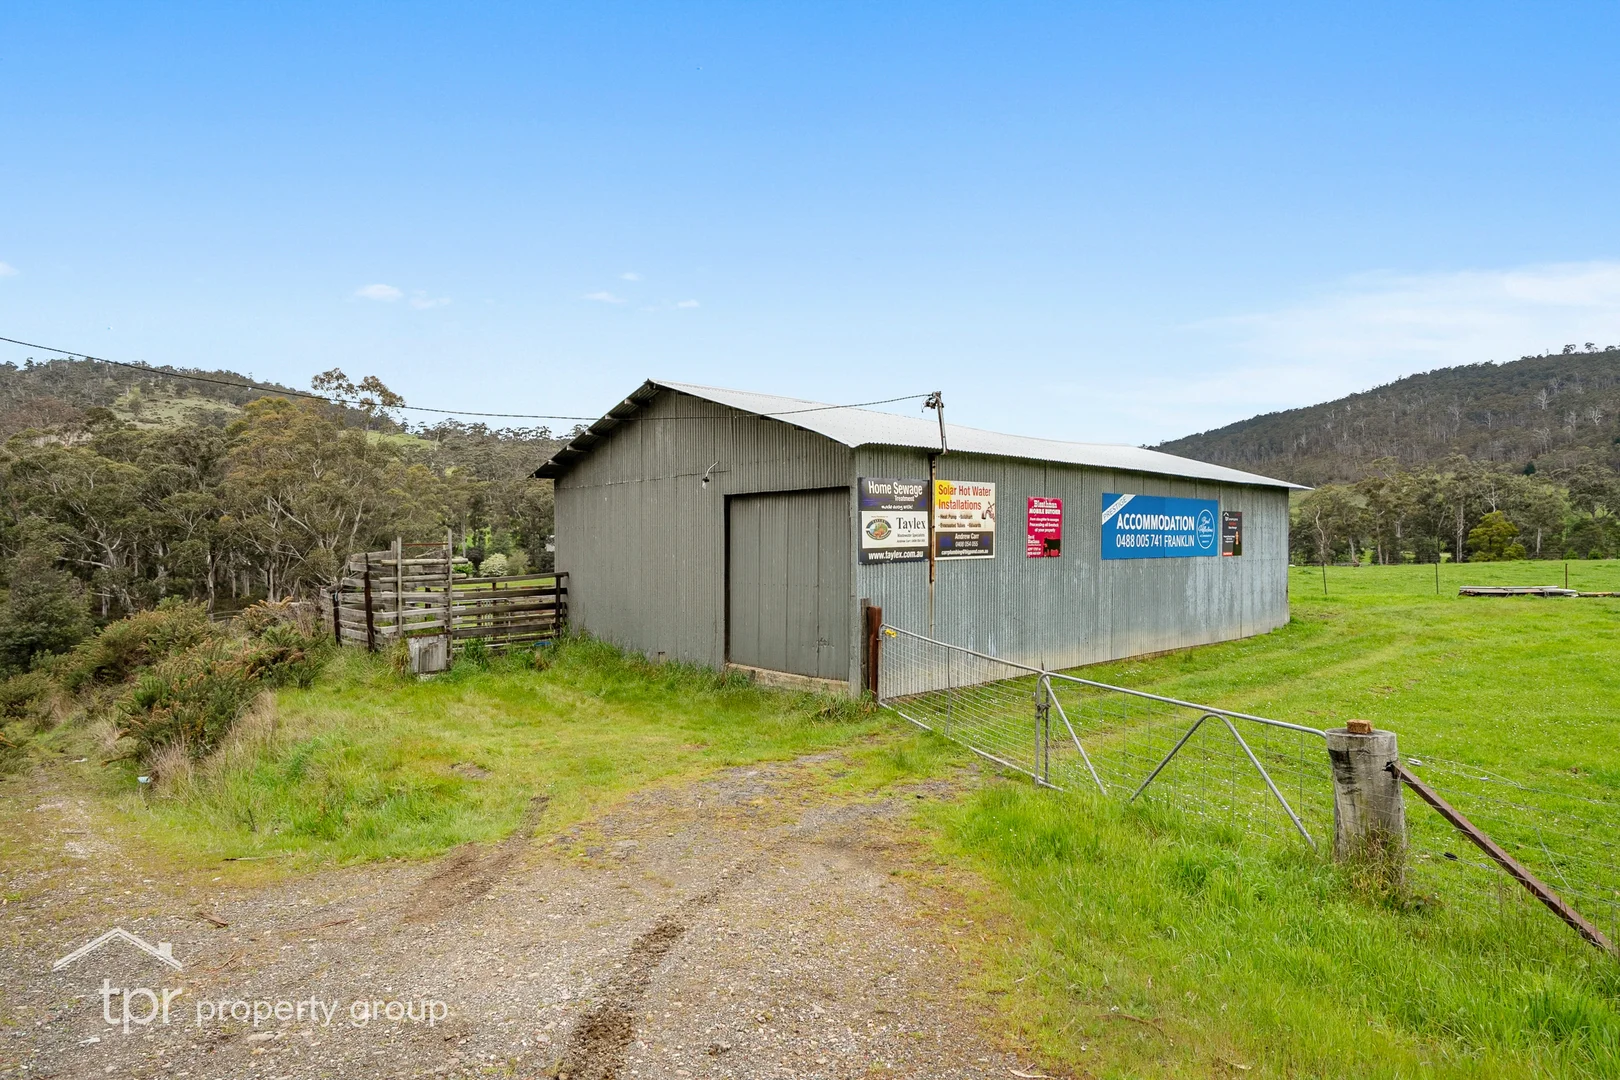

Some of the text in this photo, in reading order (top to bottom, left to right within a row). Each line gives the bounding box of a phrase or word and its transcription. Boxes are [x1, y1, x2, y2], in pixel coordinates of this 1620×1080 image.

[868, 480, 923, 498] Home Sewage
[938, 484, 991, 497] Solar Hot Water
[938, 499, 982, 510] Installations
[1102, 496, 1127, 519] PRESTIGE
[896, 517, 926, 533] Taylex
[1116, 514, 1194, 531] ACCOMMODATION
[1116, 534, 1195, 548] 0488 005 741 FRANKLIN
[868, 550, 924, 560] www.taylex.com.au
